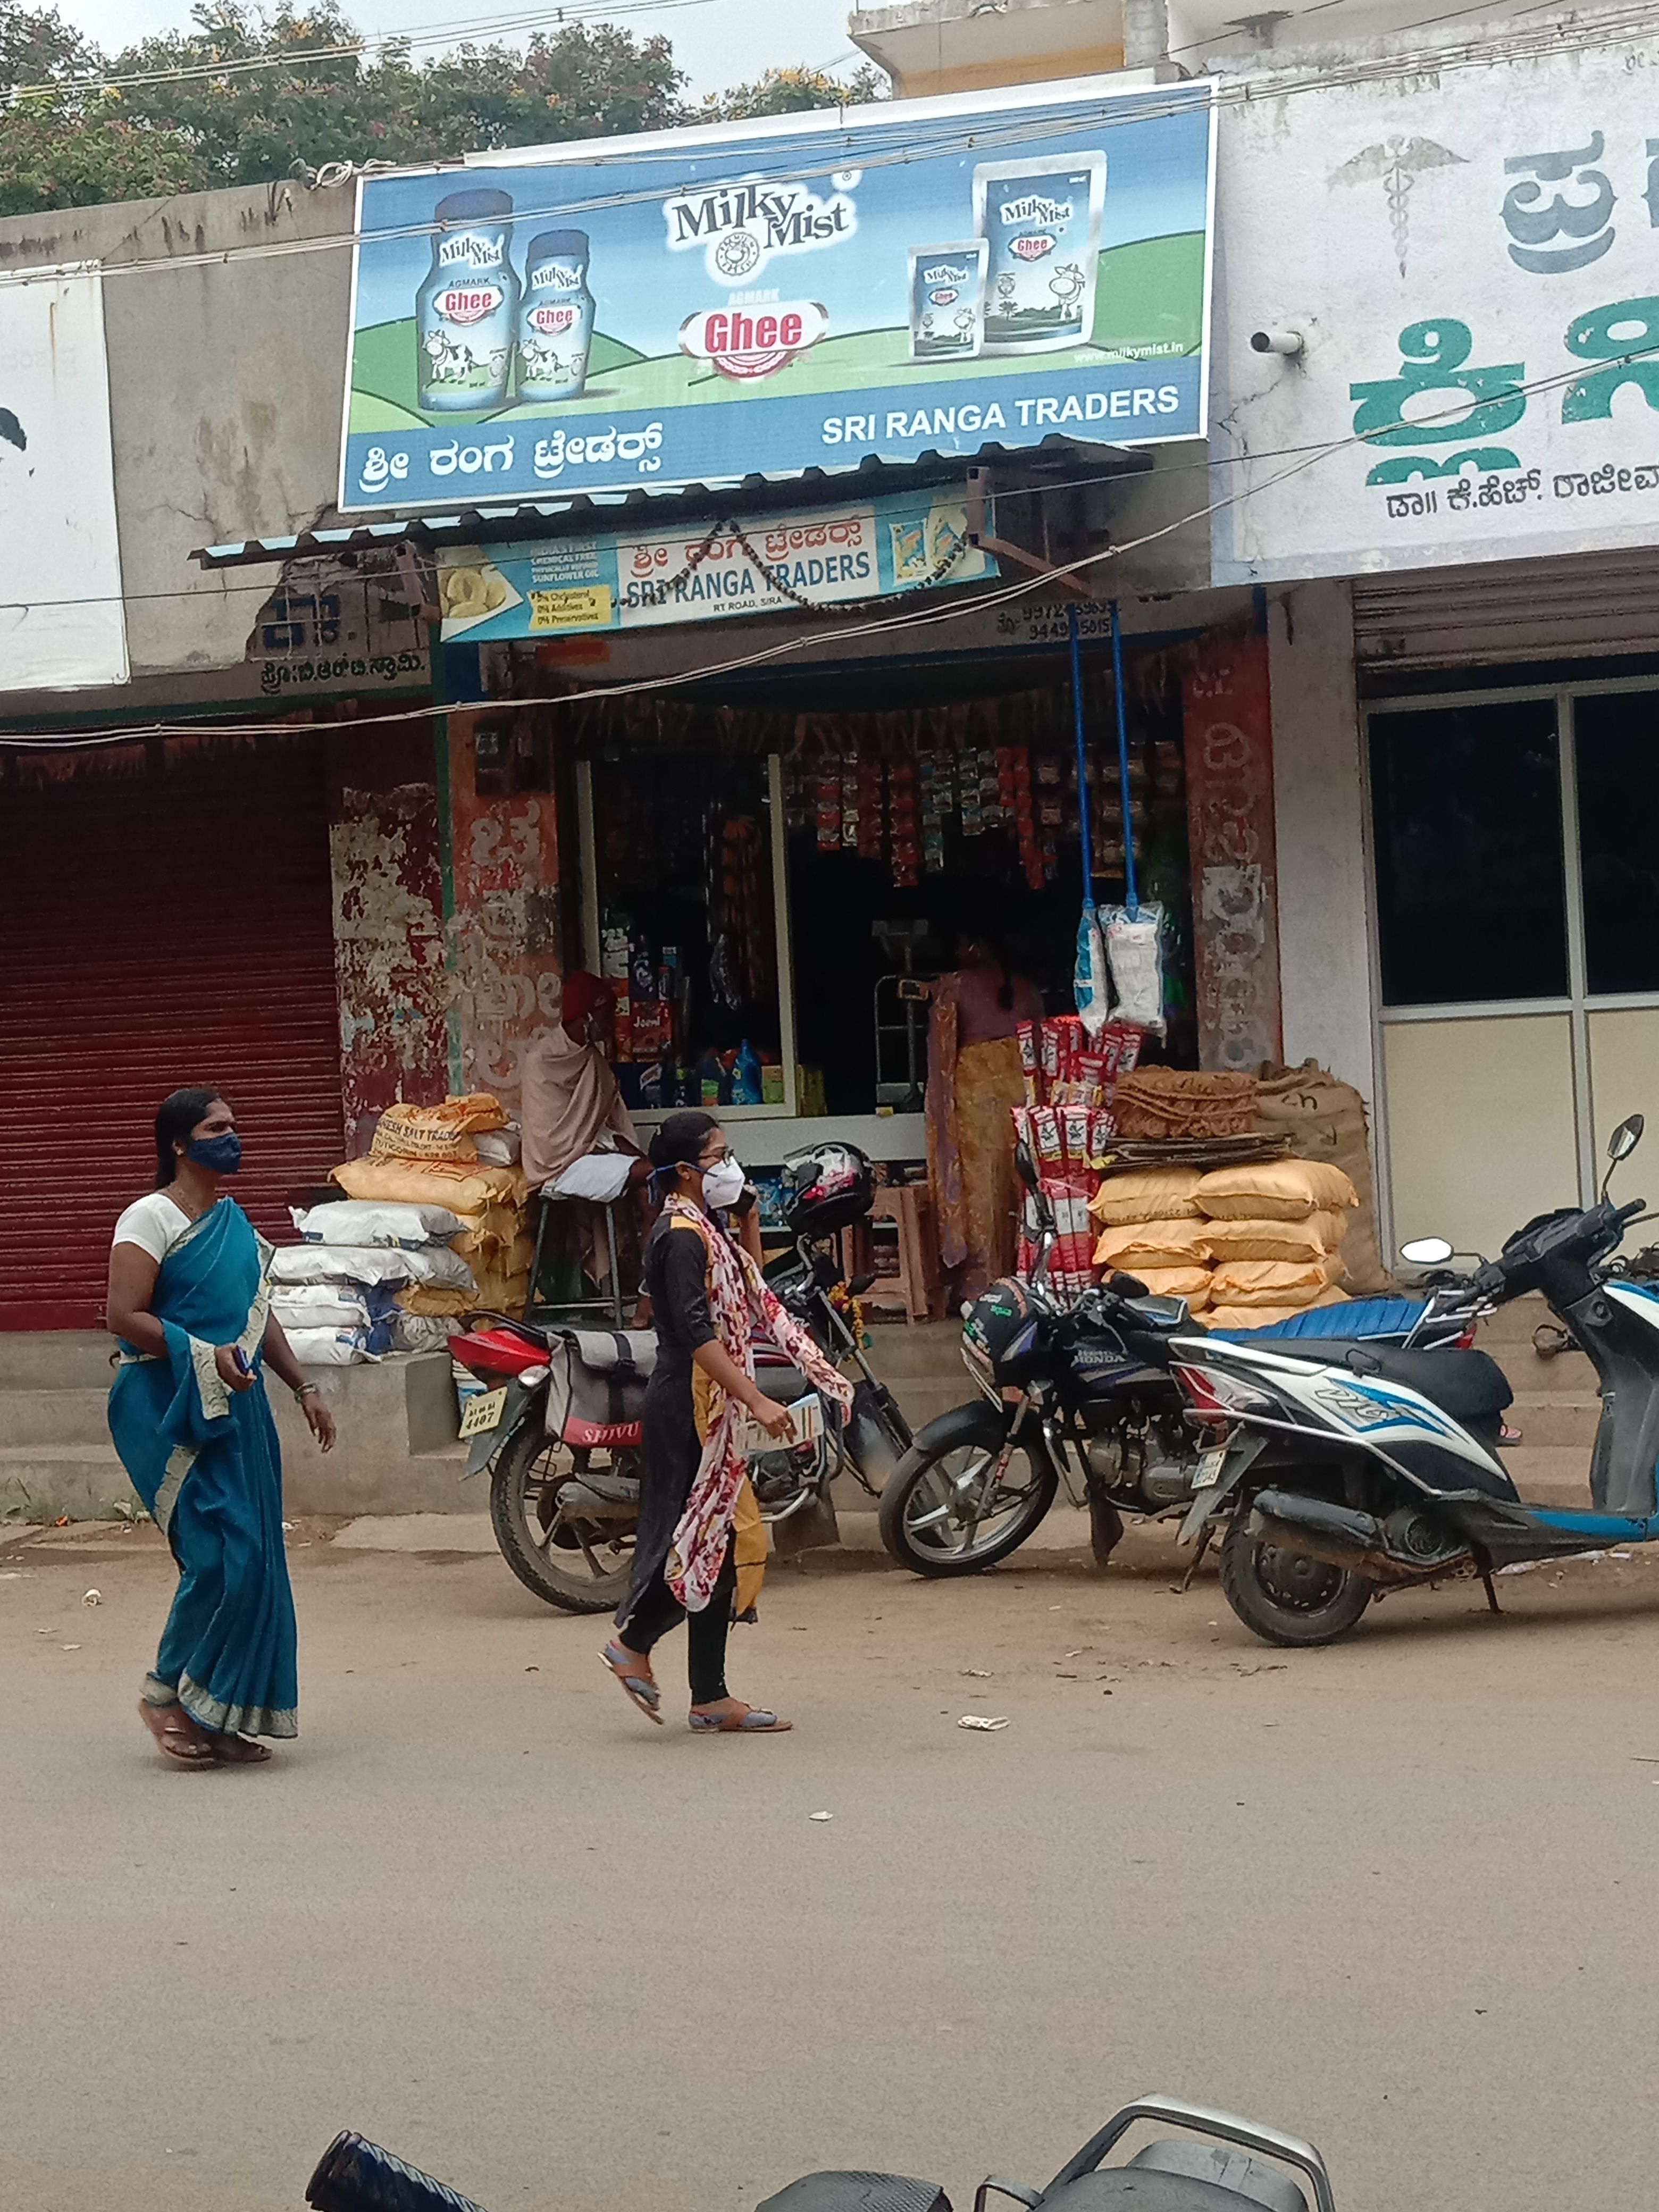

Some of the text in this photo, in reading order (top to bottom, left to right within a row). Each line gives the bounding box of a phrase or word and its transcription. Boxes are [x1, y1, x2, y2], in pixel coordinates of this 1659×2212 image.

[672, 186, 849, 249] Milky Mist
[1017, 238, 1048, 252] Ghee
[445, 292, 492, 312] Ghee
[536, 309, 573, 324] Ghee
[705, 312, 802, 354] Ghee
[822, 386, 1180, 446] SRI RANGA TRADERS
[359, 447, 409, 493] ಶ್ರೀ
[430, 434, 515, 474] ರಂಗ
[626, 551, 871, 609] SRI RANGA TRADERS
[631, 543, 668, 579] ಶ್ರೀ
[582, 1422, 640, 1443] SHIVU
